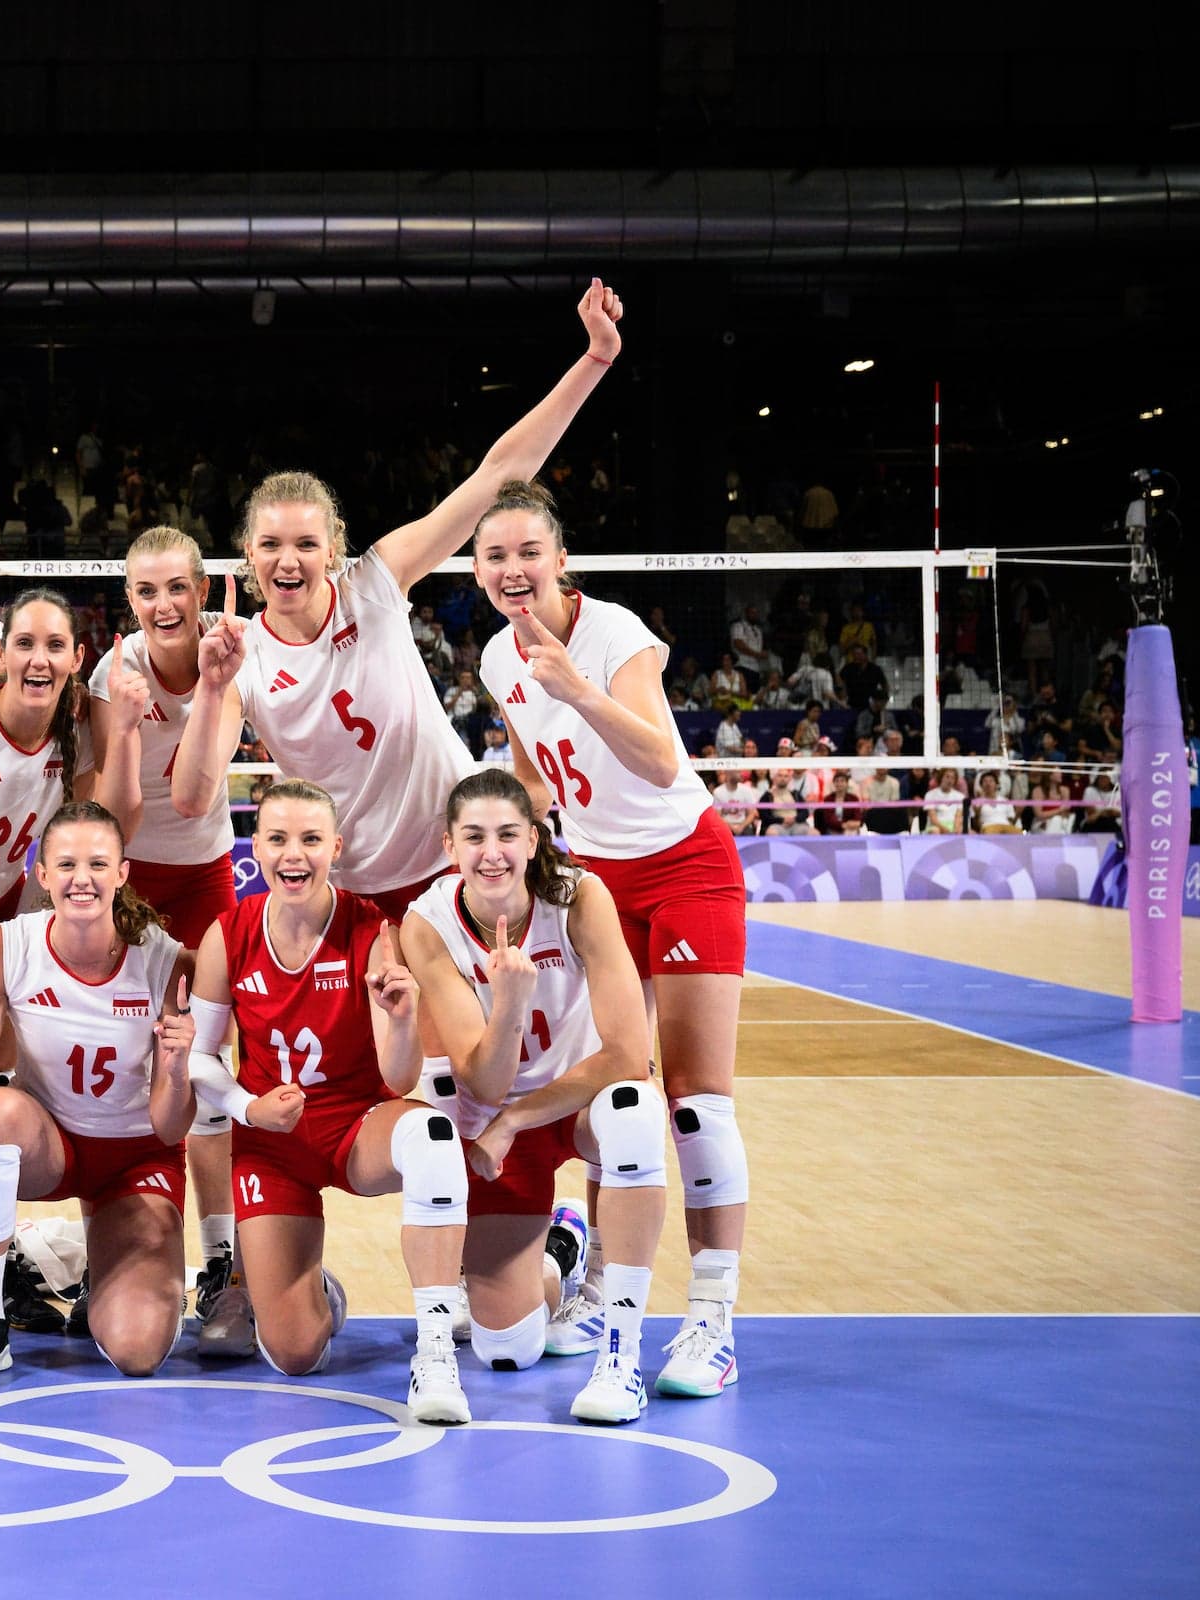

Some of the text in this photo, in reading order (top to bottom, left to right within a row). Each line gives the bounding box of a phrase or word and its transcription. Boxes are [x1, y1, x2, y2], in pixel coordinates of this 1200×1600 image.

[80, 563, 125, 573] 2024
[702, 556, 748, 567] 2024
[331, 689, 376, 751] 5
[536, 739, 592, 809] 95
[1151, 752, 1172, 827] 2024
[315, 977, 350, 991] POLSKA
[113, 1008, 149, 1017] POLSKA
[519, 1009, 552, 1062] 1
[66, 1044, 117, 1098] 15
[270, 1026, 328, 1086] 12
[240, 1173, 264, 1205] 12
